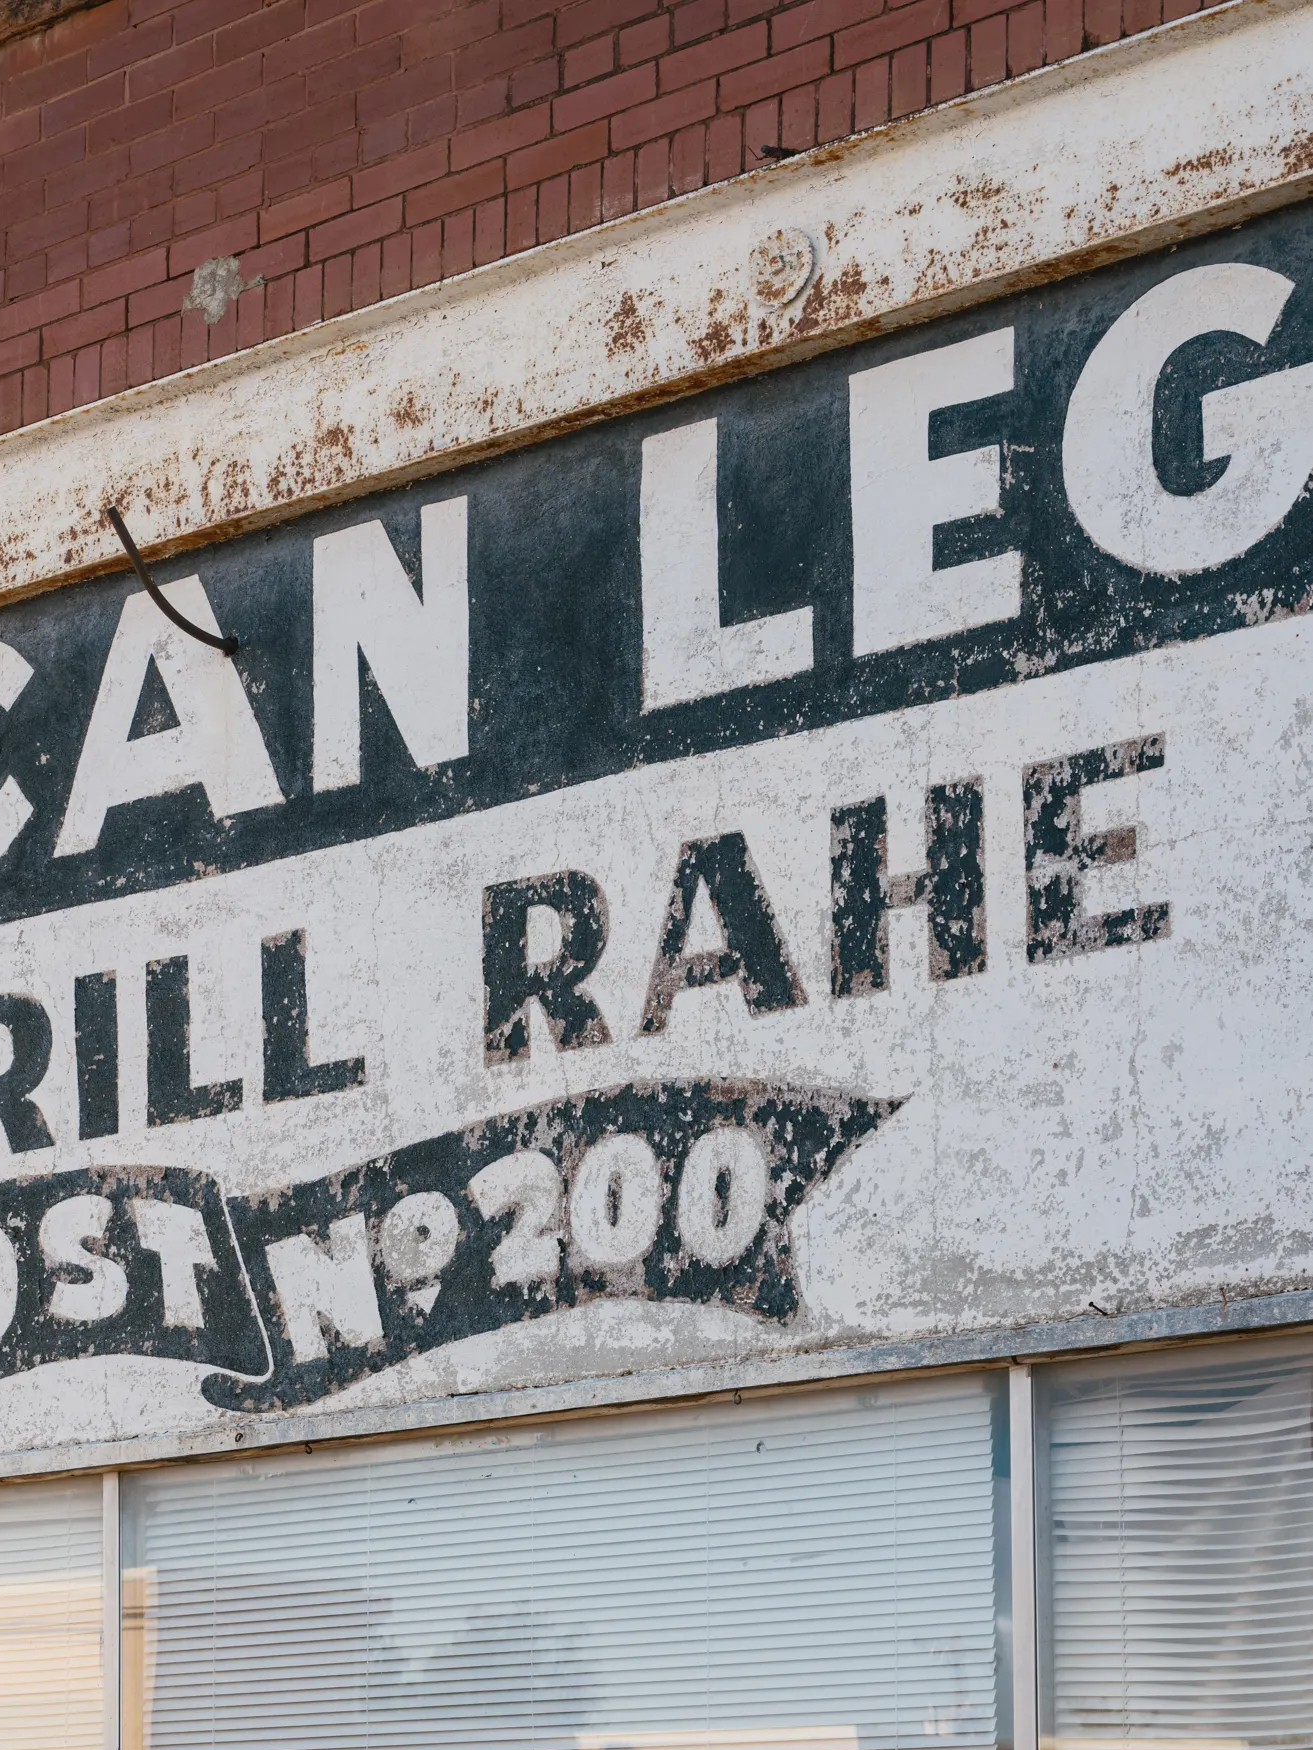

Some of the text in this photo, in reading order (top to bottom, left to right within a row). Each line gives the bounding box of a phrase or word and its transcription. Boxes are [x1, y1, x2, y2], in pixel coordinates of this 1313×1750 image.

[639, 262, 1313, 714] LEG
[483, 731, 1173, 1067] RAHE
[467, 1122, 771, 1295] 200
